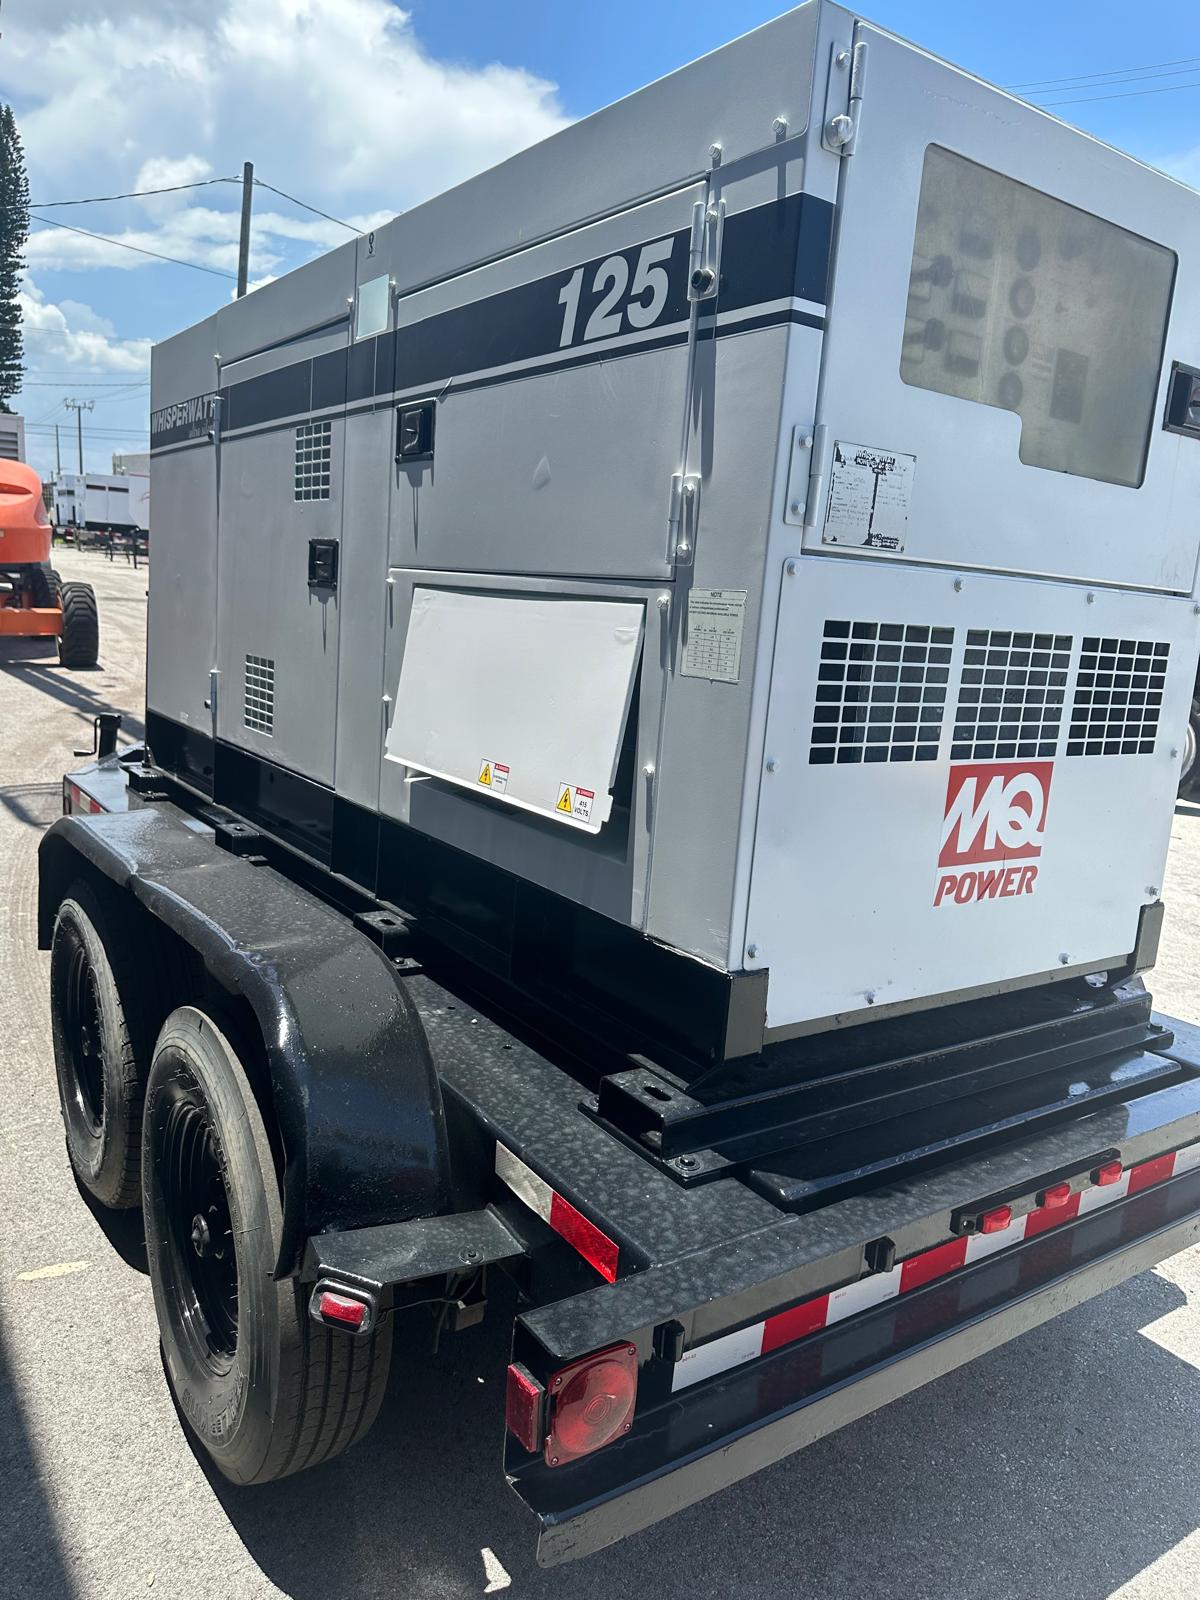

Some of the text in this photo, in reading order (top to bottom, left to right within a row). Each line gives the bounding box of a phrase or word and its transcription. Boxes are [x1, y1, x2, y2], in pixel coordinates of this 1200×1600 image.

[558, 236, 675, 348] 125
[574, 808, 589, 817] VOLTS
[579, 800, 588, 809] 415
[939, 772, 1045, 856] MQ
[933, 865, 1039, 907] POWER
